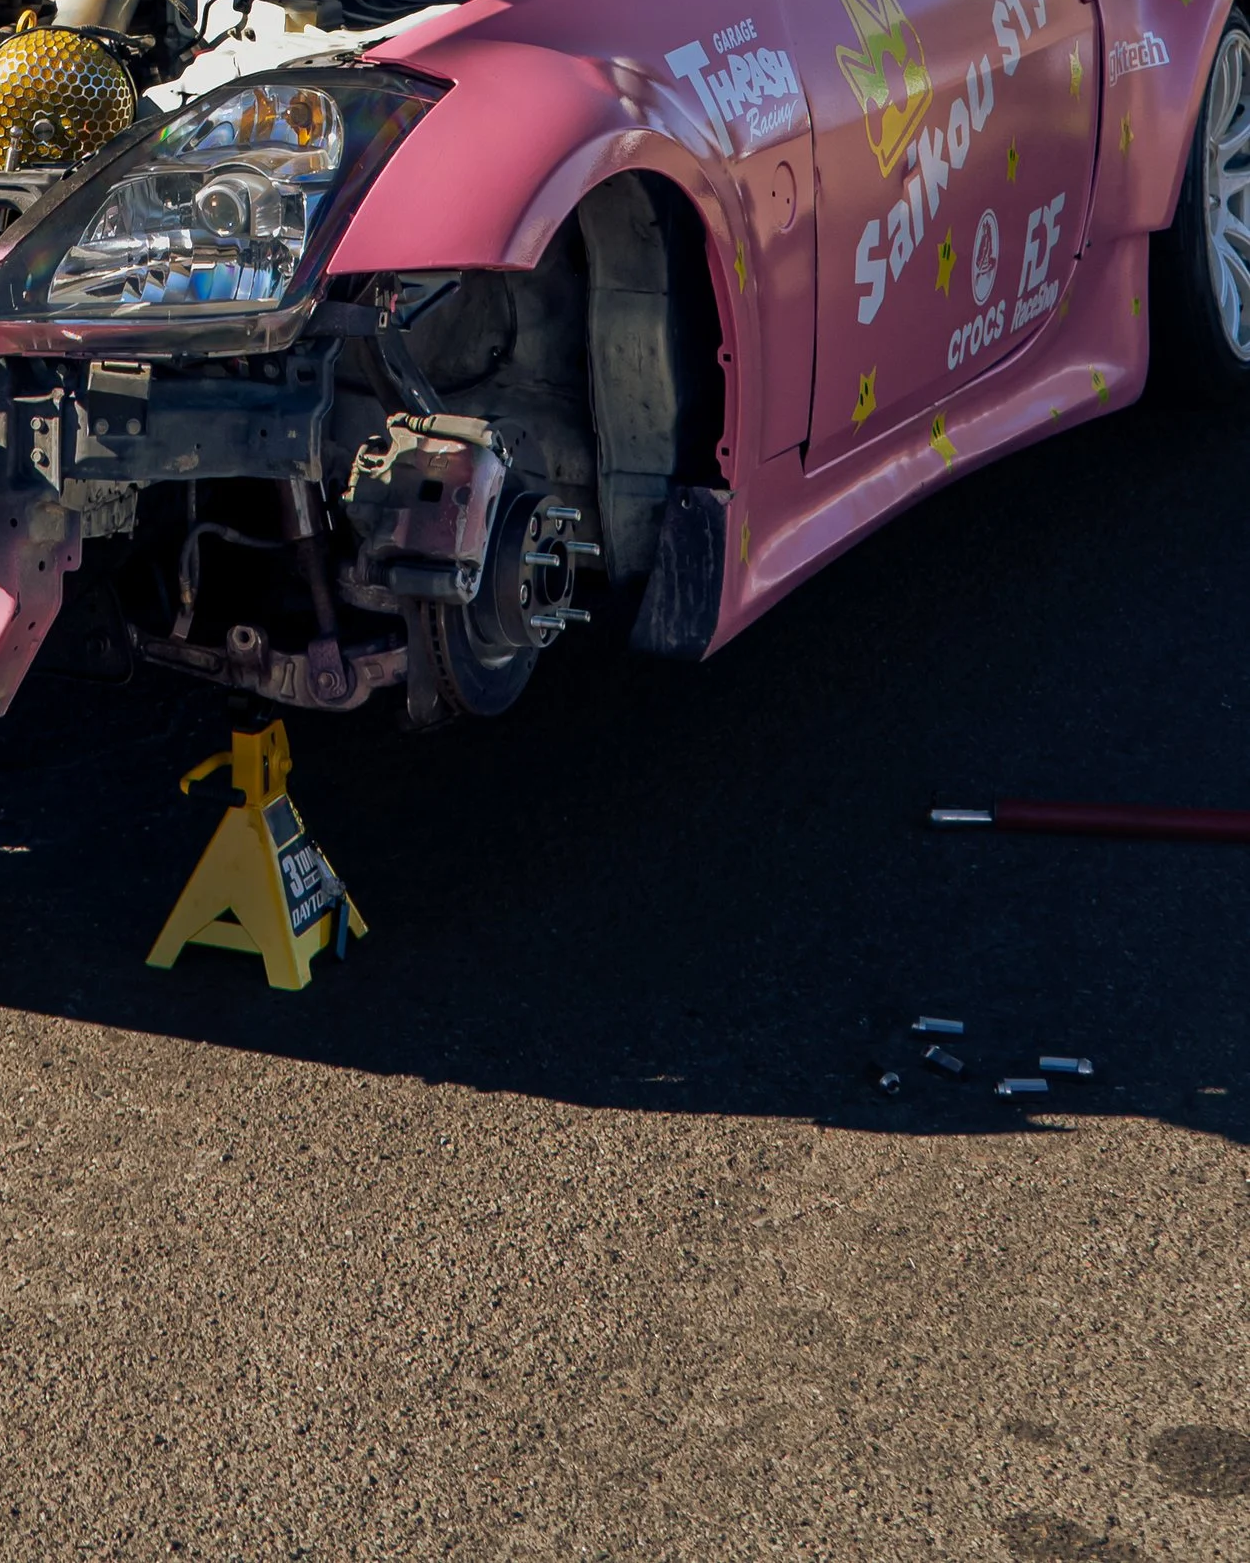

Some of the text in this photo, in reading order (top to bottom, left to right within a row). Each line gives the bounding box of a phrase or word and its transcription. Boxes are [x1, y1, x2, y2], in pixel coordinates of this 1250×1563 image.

[713, 18, 758, 54] GARAGE
[746, 99, 799, 142] Racing
[855, 54, 995, 325] Saikou
[947, 299, 1006, 370] crocs
[282, 854, 305, 899] 3
